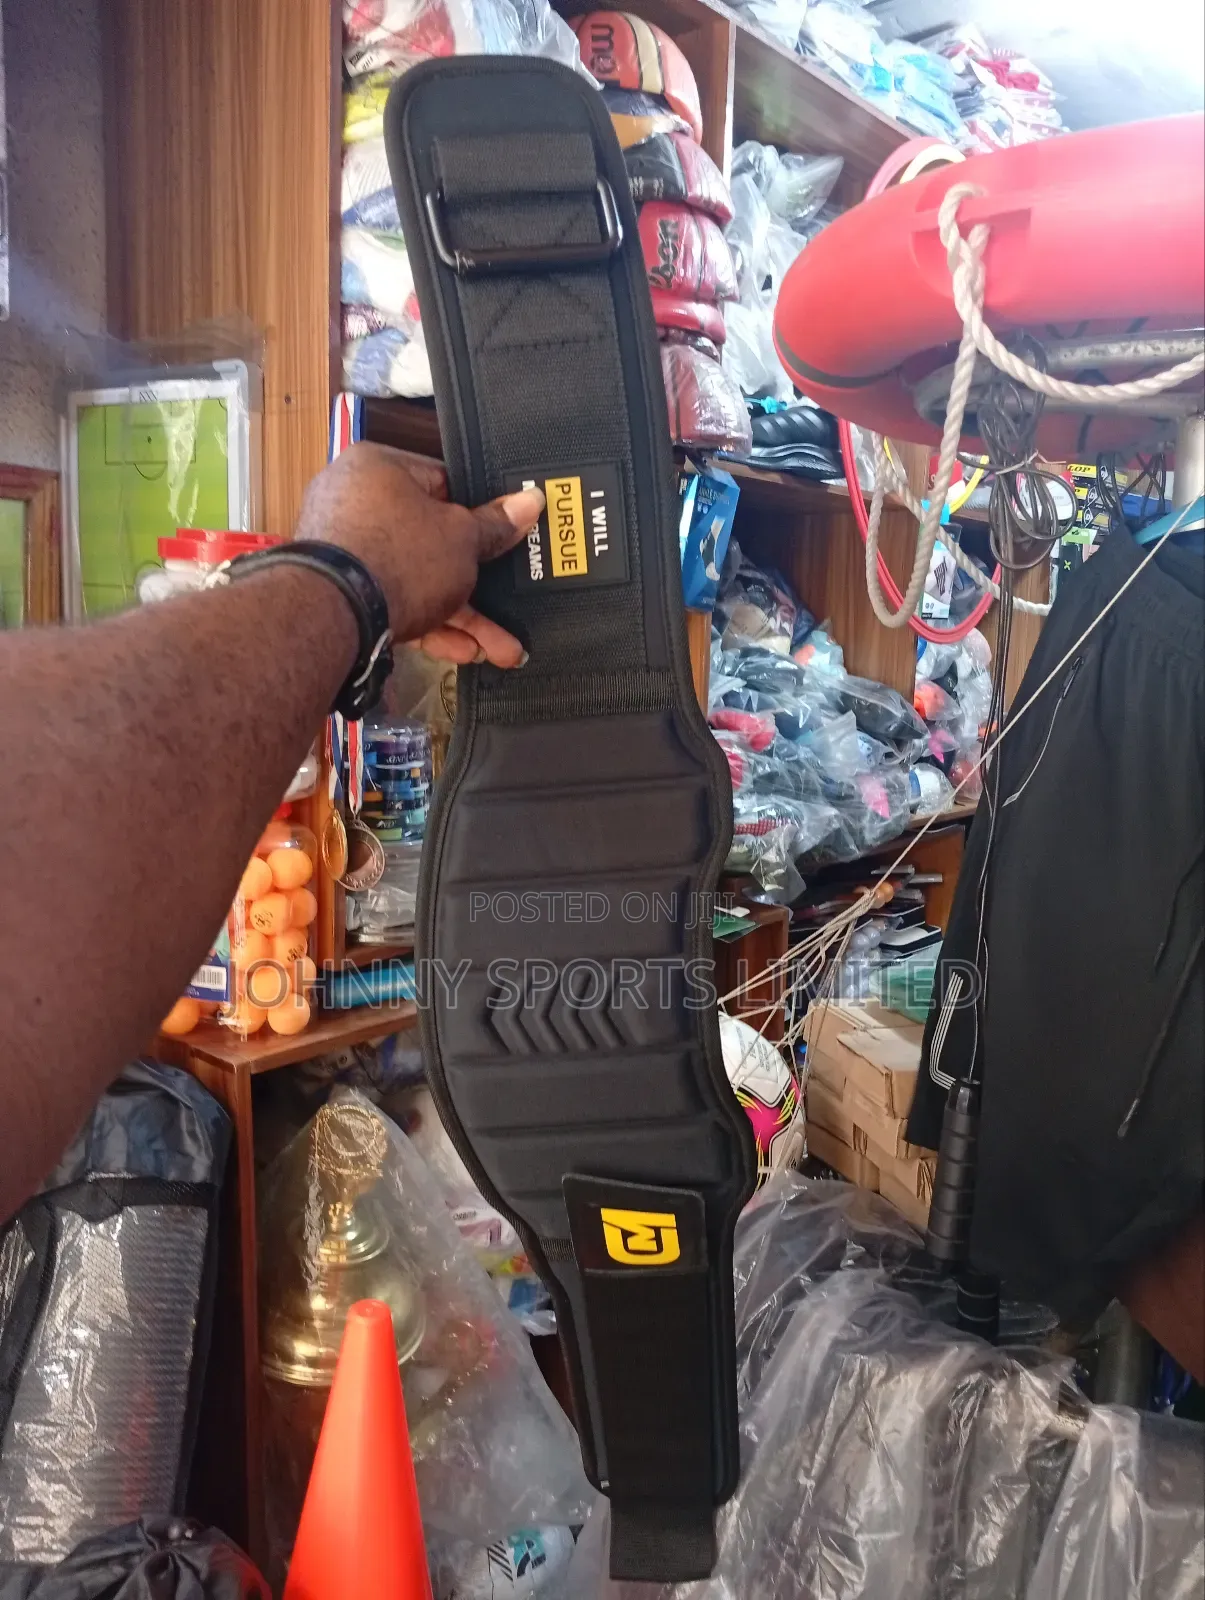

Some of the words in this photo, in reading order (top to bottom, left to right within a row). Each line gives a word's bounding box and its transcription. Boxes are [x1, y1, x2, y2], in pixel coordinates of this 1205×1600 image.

[590, 490, 605, 498] I
[555, 482, 578, 571] PURSUE
[591, 505, 609, 557] WILL
